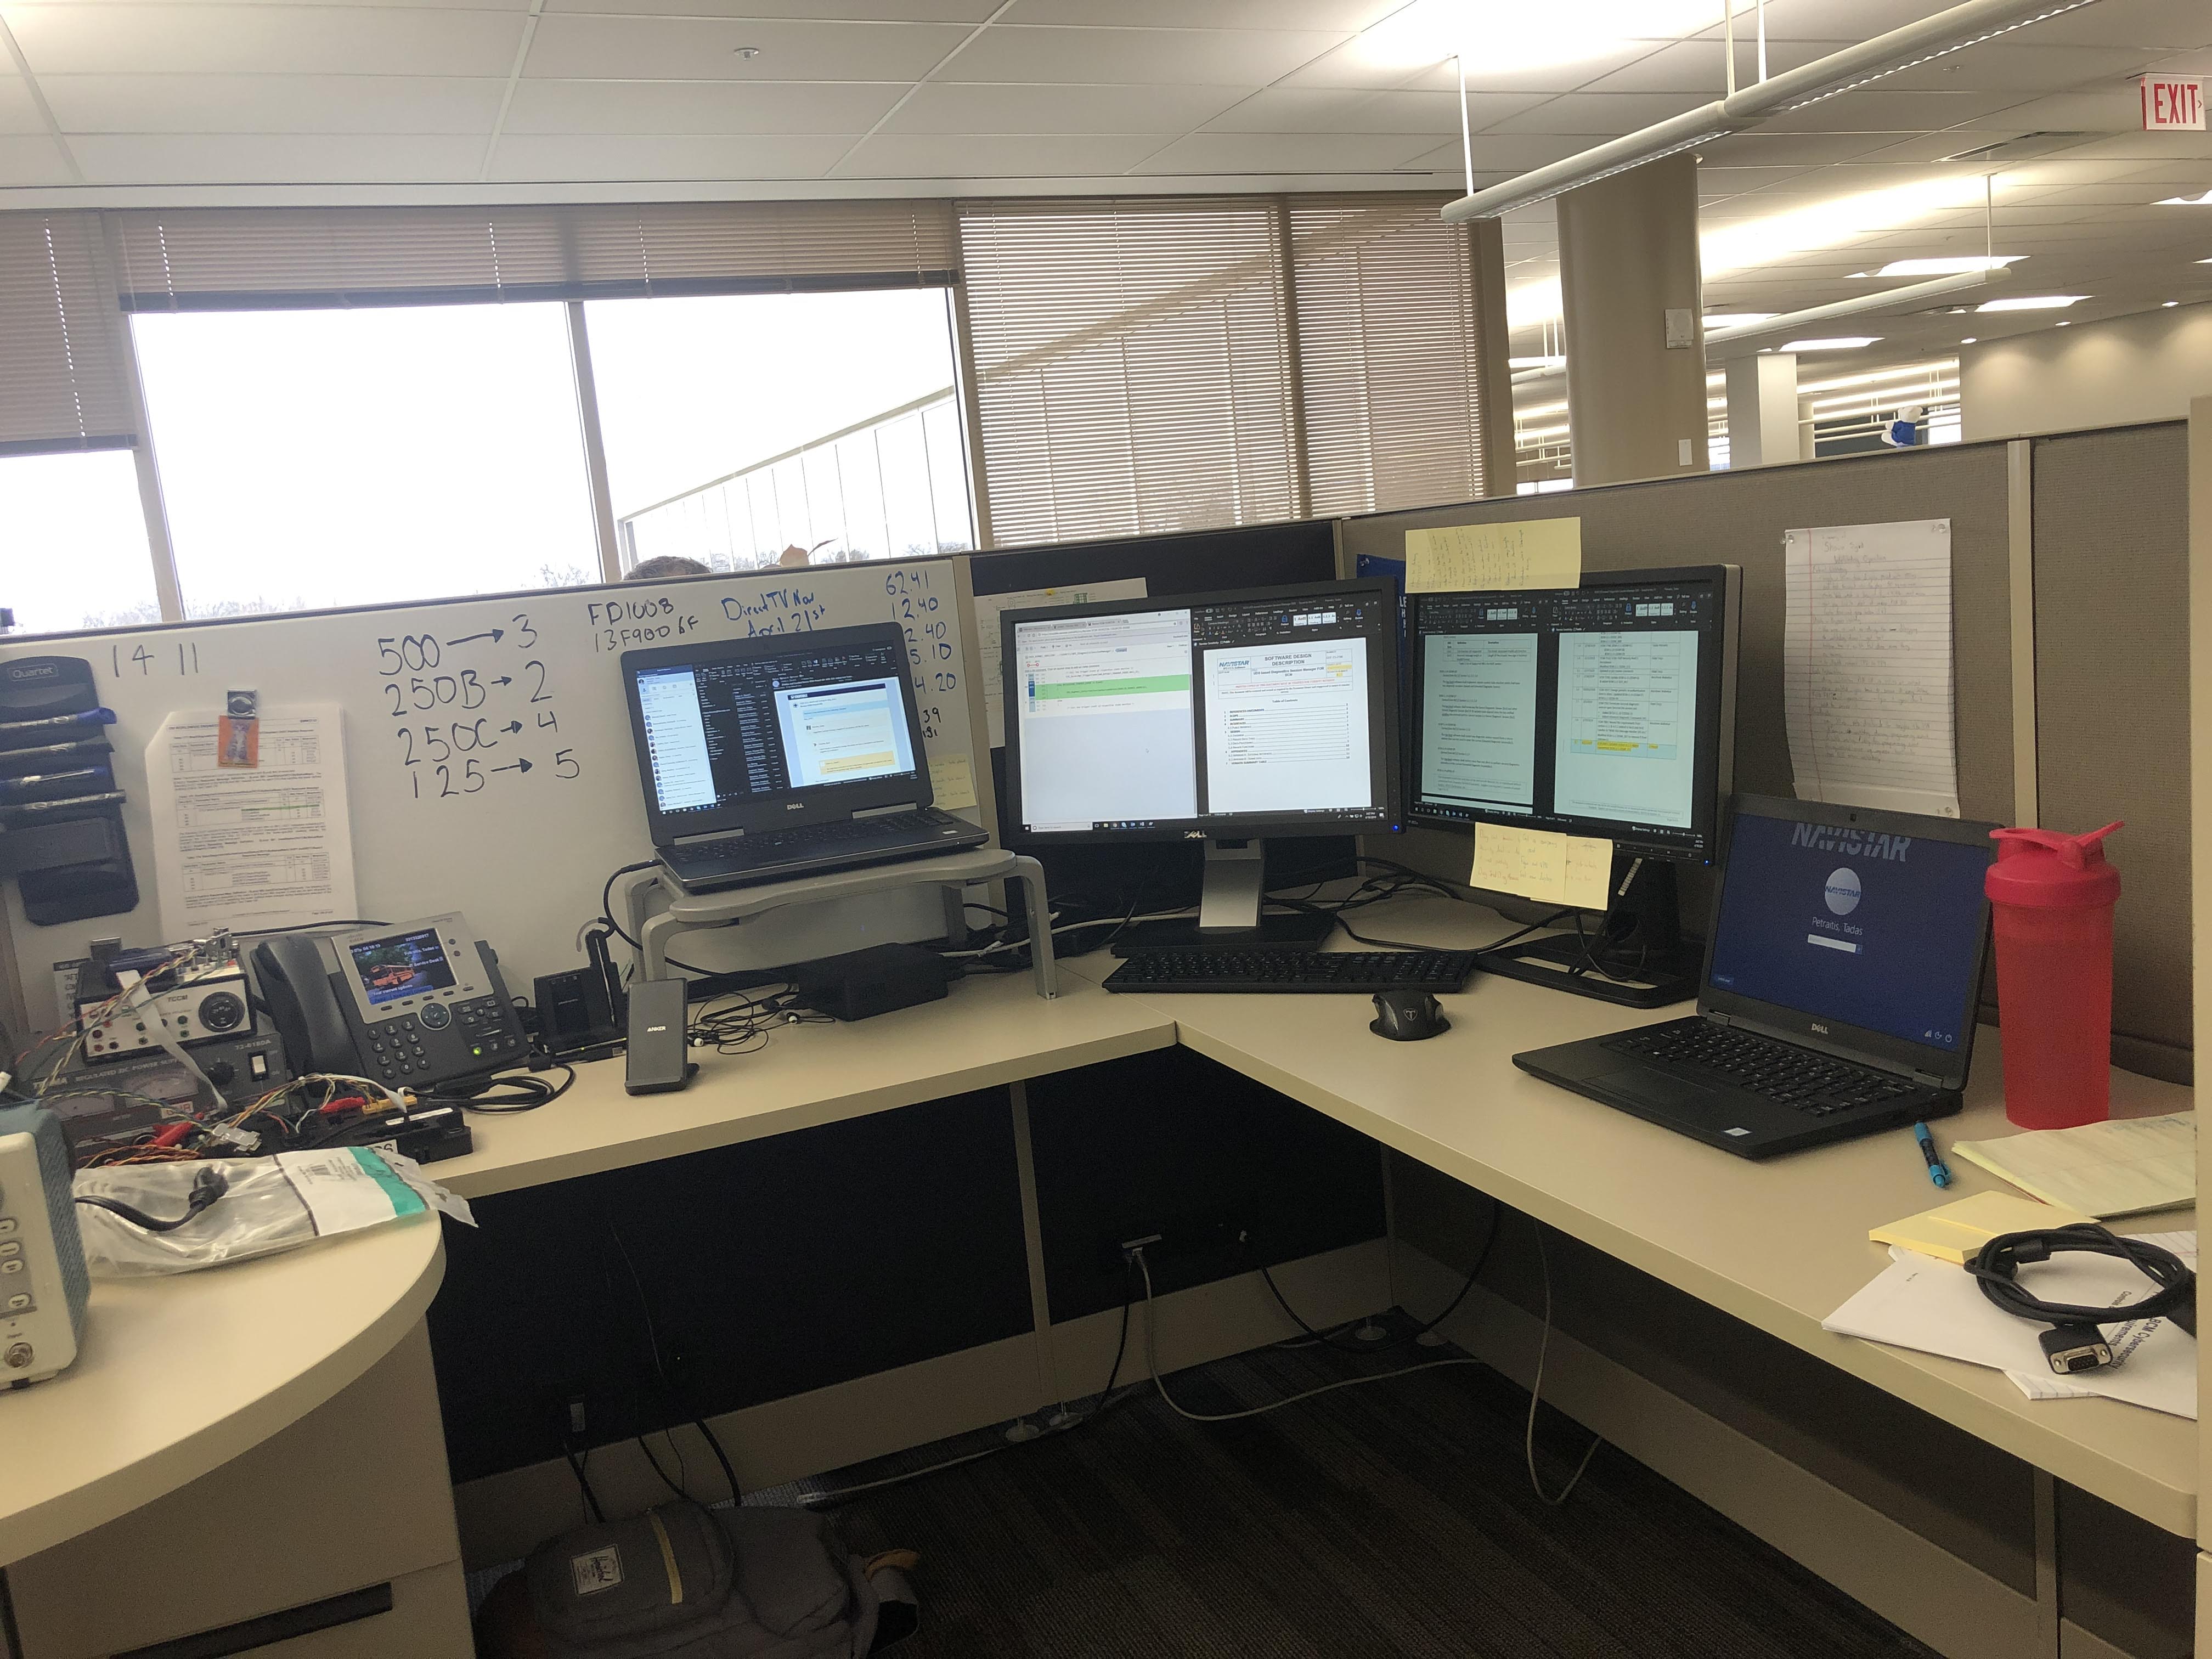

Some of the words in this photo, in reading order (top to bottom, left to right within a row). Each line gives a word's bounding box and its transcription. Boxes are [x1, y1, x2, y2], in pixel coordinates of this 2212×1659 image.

[2154, 84, 2198, 123] EXIT
[886, 570, 928, 595] 62.41
[892, 597, 938, 620] 12.40
[378, 635, 440, 675] 500
[512, 614, 537, 648] 3
[13, 667, 53, 679] Quartet
[385, 669, 486, 716] 250B
[525, 661, 552, 703] 2
[398, 718, 498, 766] 250C
[538, 711, 558, 733] 4
[413, 759, 485, 799] 125
[555, 749, 580, 779] 5
[1184, 831, 1207, 839] DELL
[1791, 822, 1911, 862] NAVISTAR
[1825, 885, 1861, 899] NAVISTAR
[1812, 916, 1841, 932] Petraitis,
[1843, 922, 1863, 936] Tadas
[1812, 1023, 1828, 1035] DELL
[75, 1070, 117, 1082] REGULATED
[132, 1061, 159, 1071] POWER
[2112, 1290, 2132, 1306] Controls
[2142, 1318, 2162, 1333] BCM
[2110, 1332, 2151, 1369] Cybersecurity
